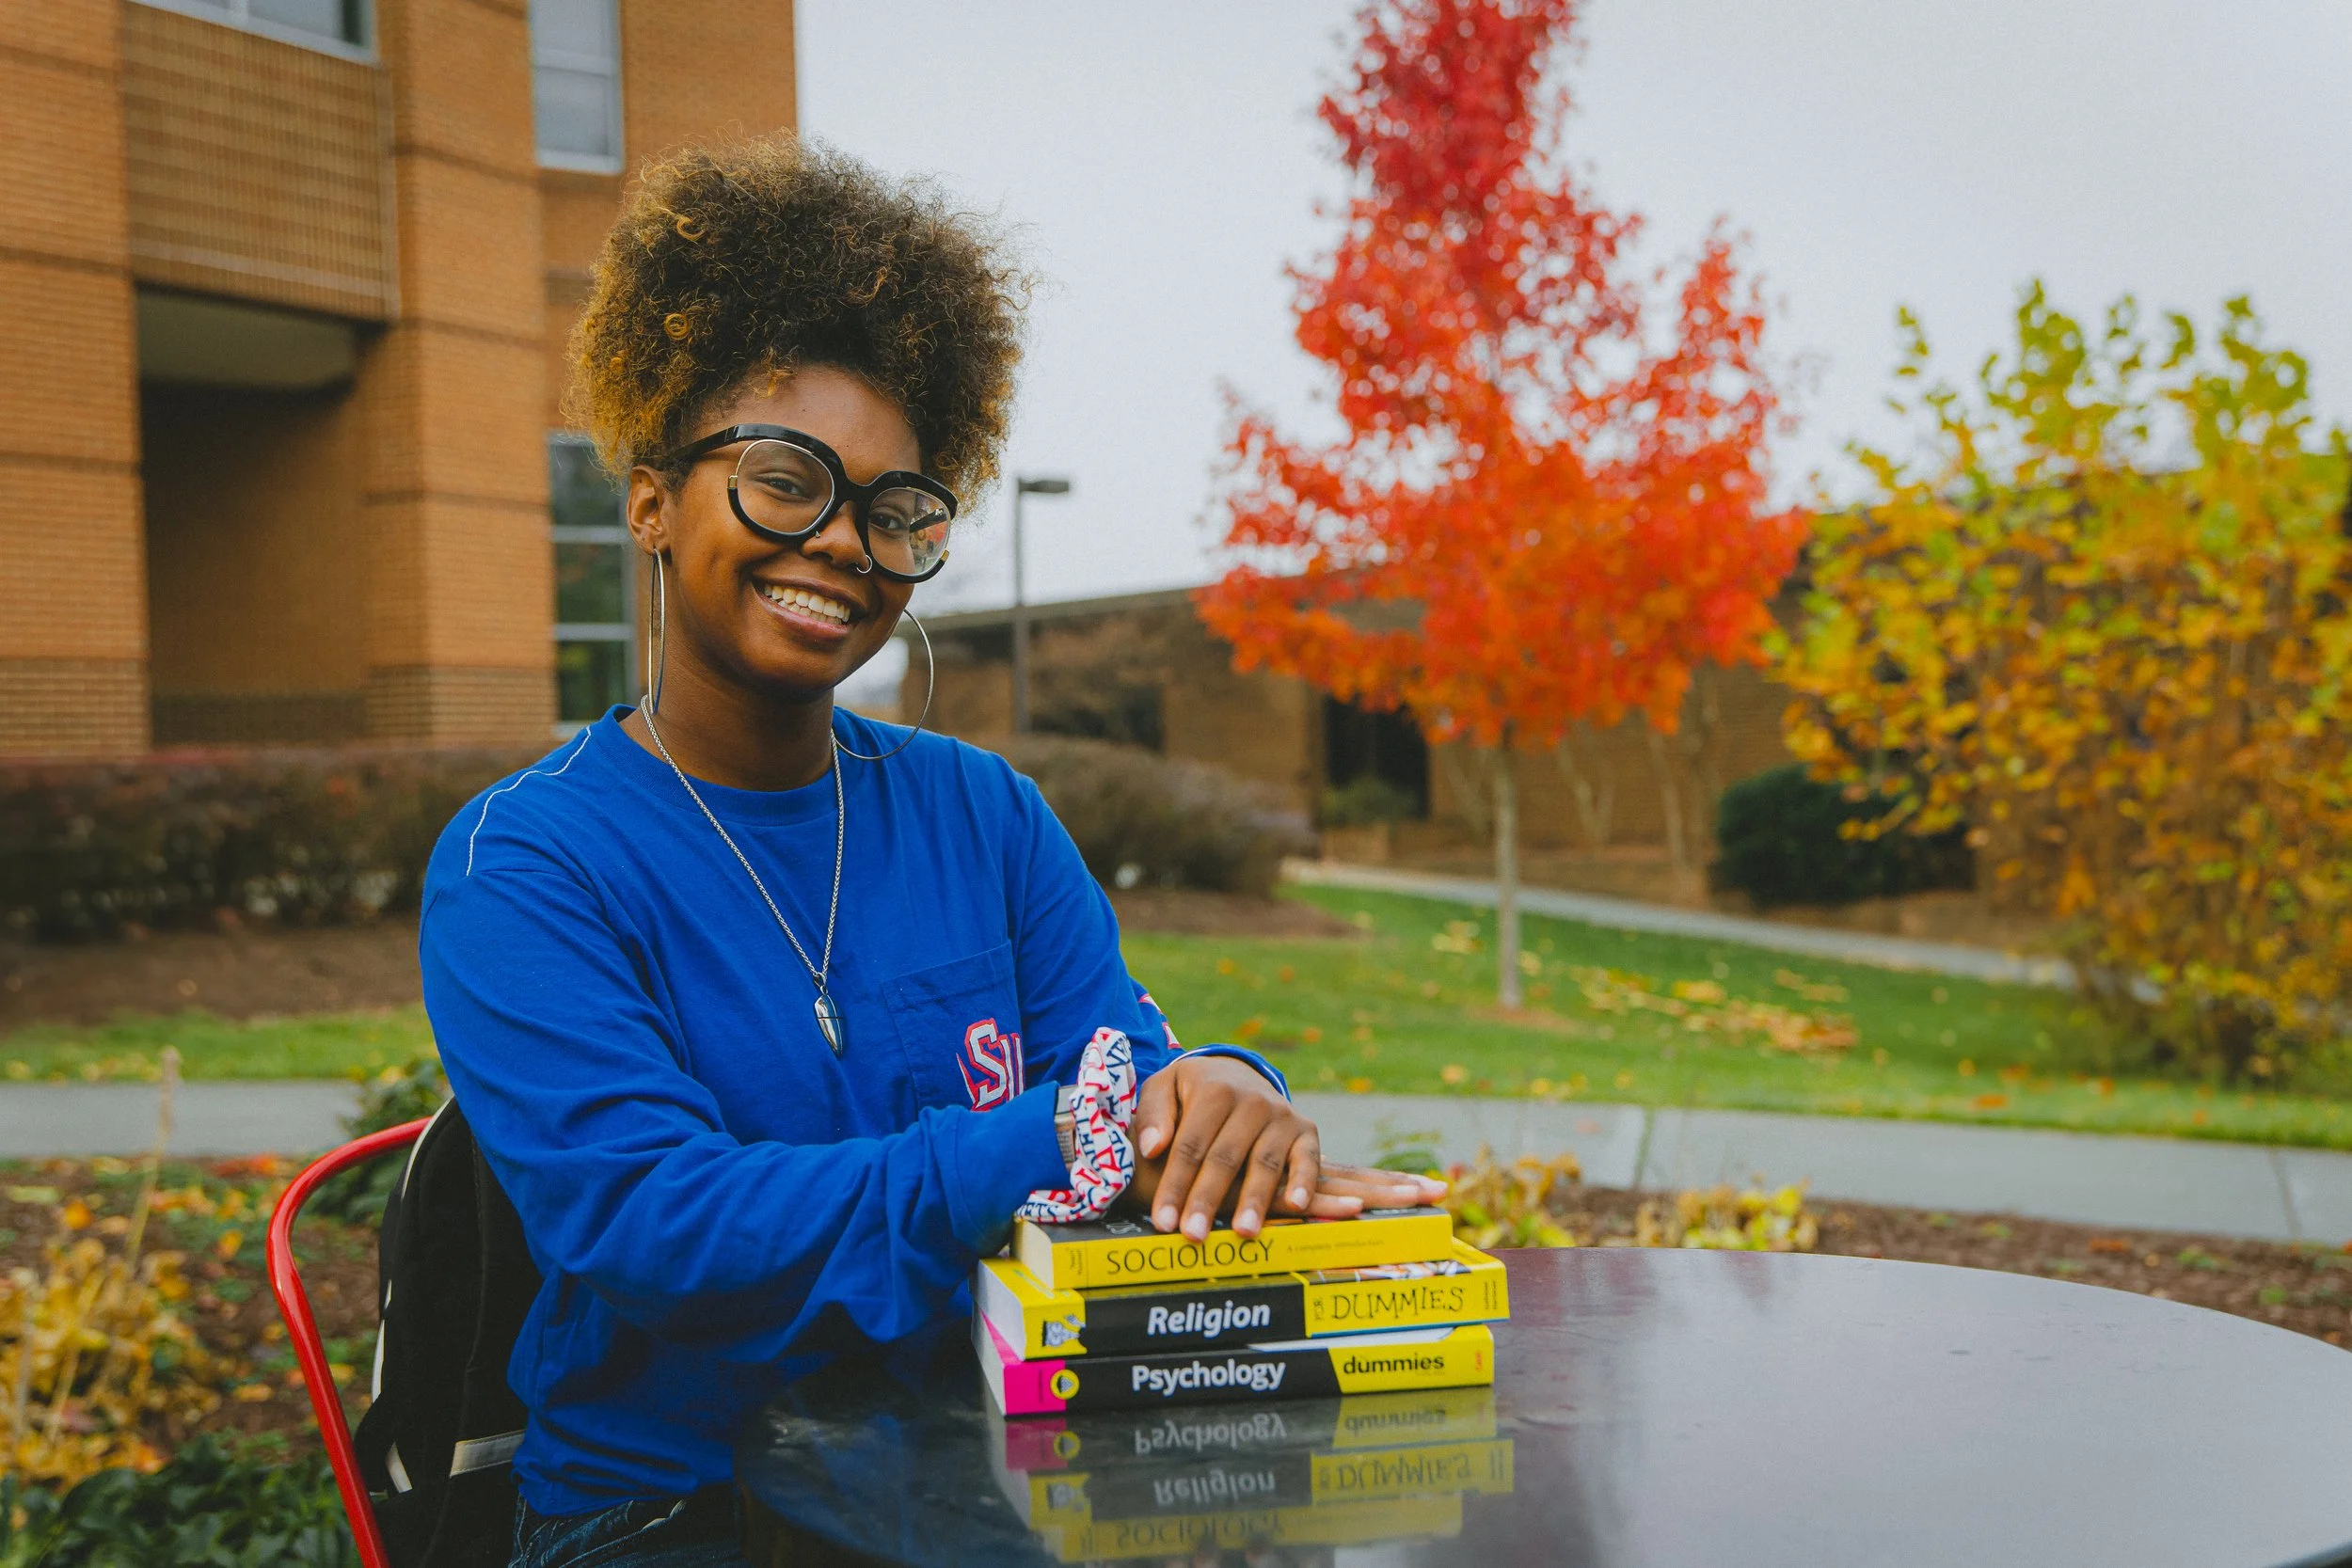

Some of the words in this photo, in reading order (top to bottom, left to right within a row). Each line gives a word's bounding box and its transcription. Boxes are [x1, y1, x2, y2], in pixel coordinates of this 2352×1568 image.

[1106, 1238, 1274, 1275] SOCIOLOGY
[1147, 1300, 1270, 1338] Religion
[1331, 1286, 1466, 1320] DUMMIES
[1132, 1358, 1286, 1397] Psychology
[1343, 1353, 1444, 1374] dummies
